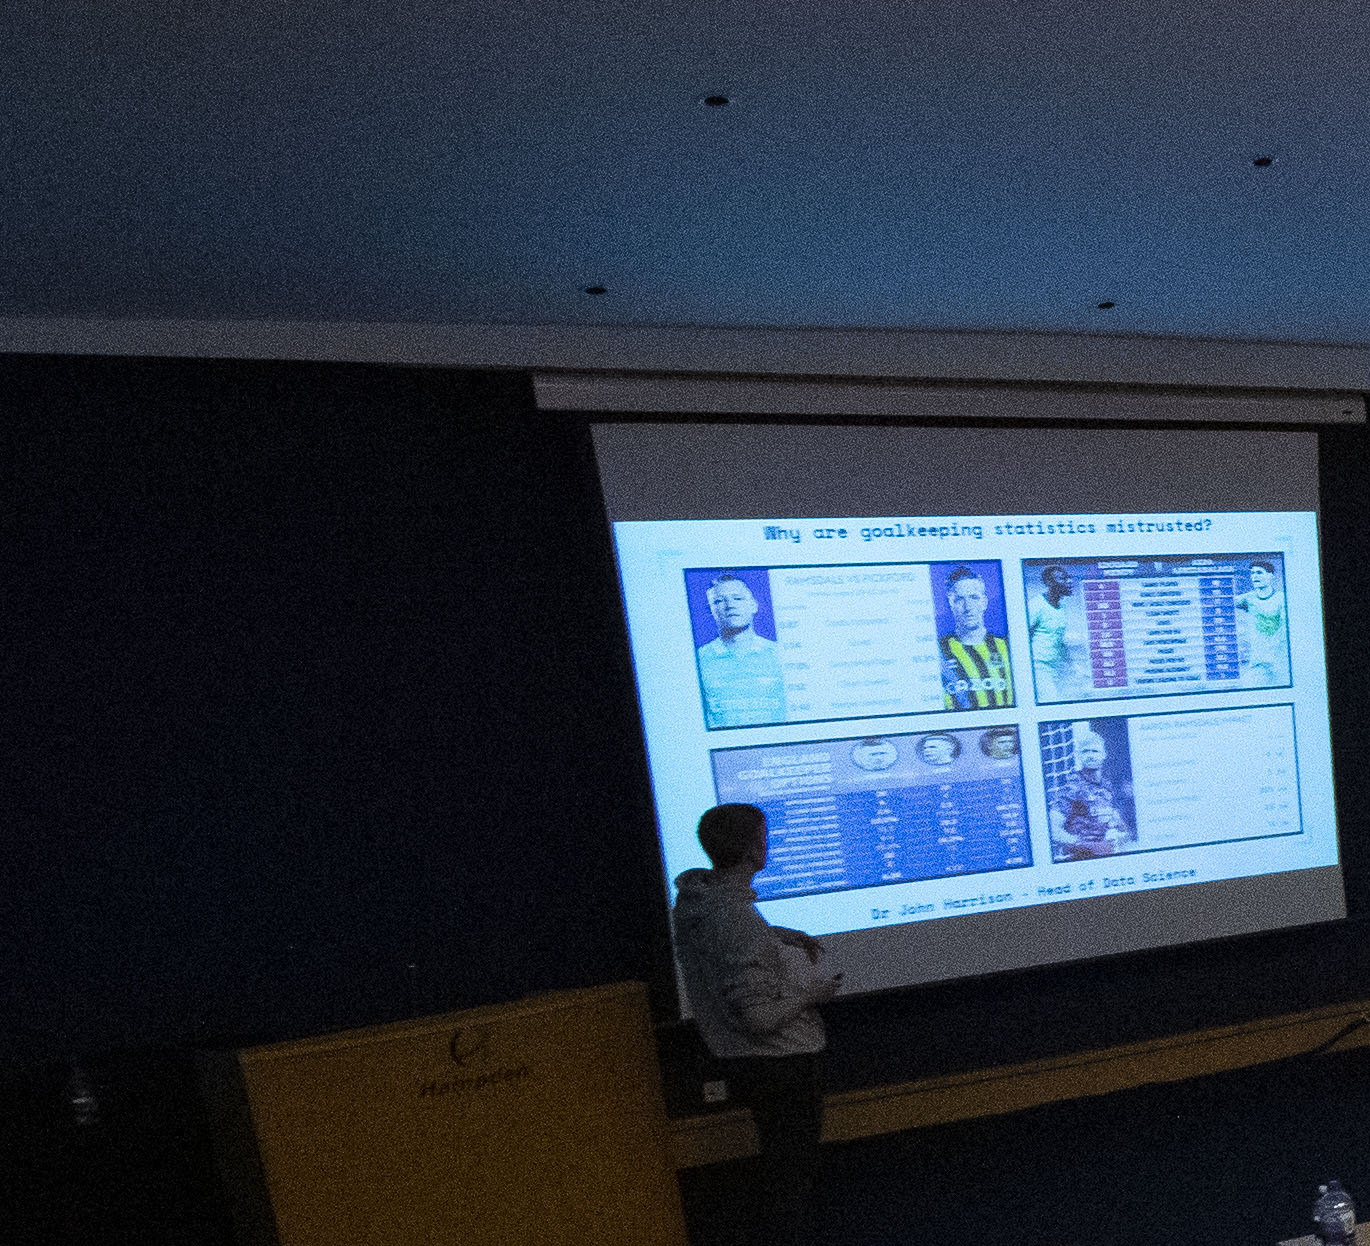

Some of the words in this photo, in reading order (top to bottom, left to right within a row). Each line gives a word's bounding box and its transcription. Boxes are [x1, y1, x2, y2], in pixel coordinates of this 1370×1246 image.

[763, 525, 801, 544] Why
[812, 526, 848, 540] are
[859, 522, 983, 543] goalkeeping
[994, 519, 1096, 536] statistics
[1106, 518, 1213, 534] mistrusted?
[870, 907, 890, 921] Dr
[900, 901, 935, 918] John
[943, 892, 1014, 911] Harrison
[1037, 881, 1071, 898] Head
[1079, 880, 1095, 893] of
[1103, 876, 1136, 891] Data
[1143, 867, 1197, 884] Science
